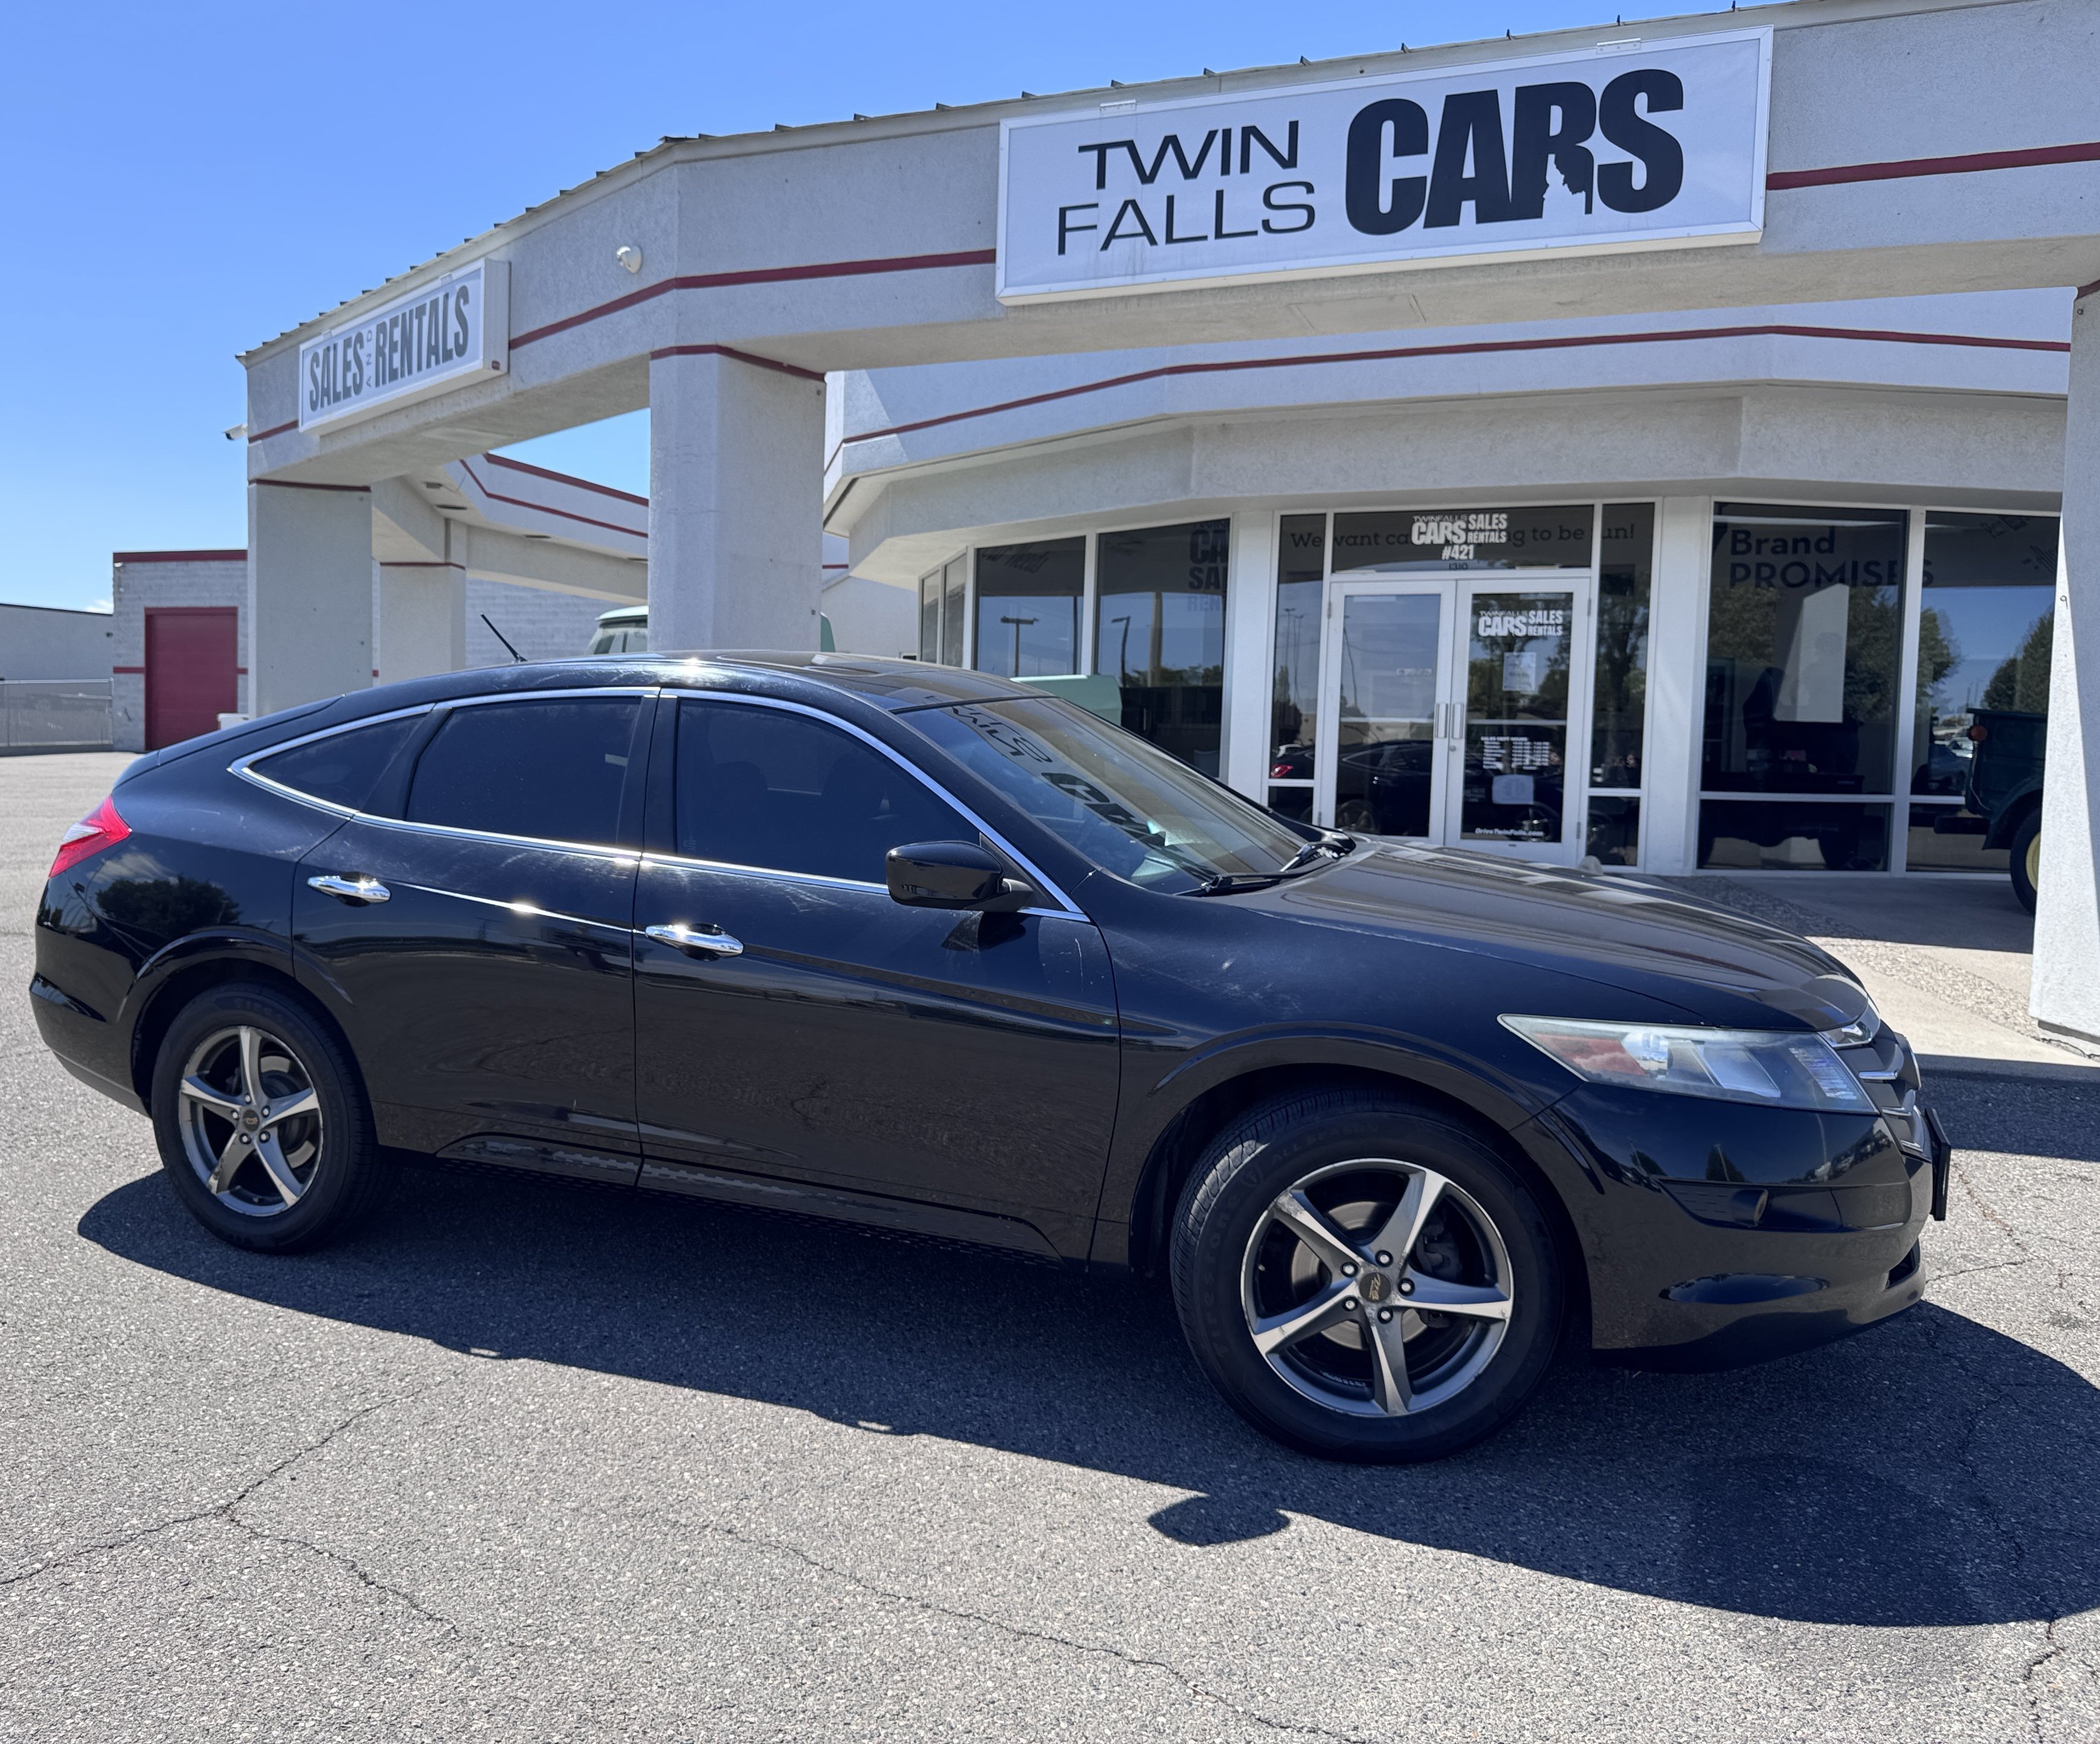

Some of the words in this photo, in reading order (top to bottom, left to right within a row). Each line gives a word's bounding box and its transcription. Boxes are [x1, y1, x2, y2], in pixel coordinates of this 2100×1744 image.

[1078, 120, 1299, 190] TWIN
[1345, 69, 1684, 236] CARS
[1058, 181, 1315, 256] FALLS
[309, 332, 364, 412] SALES
[374, 285, 469, 389] RENTALS
[1411, 521, 1466, 545] CARS
[1468, 513, 1507, 530] SALES
[1290, 531, 1323, 548] We
[1531, 527, 1552, 541] to
[1557, 523, 1585, 541] be
[1467, 531, 1507, 543] RENTALS
[1730, 526, 1835, 555] Brand
[1441, 544, 1474, 560] #421
[1478, 615, 1527, 637] CARS
[1528, 609, 1563, 624] SALES
[1528, 625, 1563, 636] RENTALS
